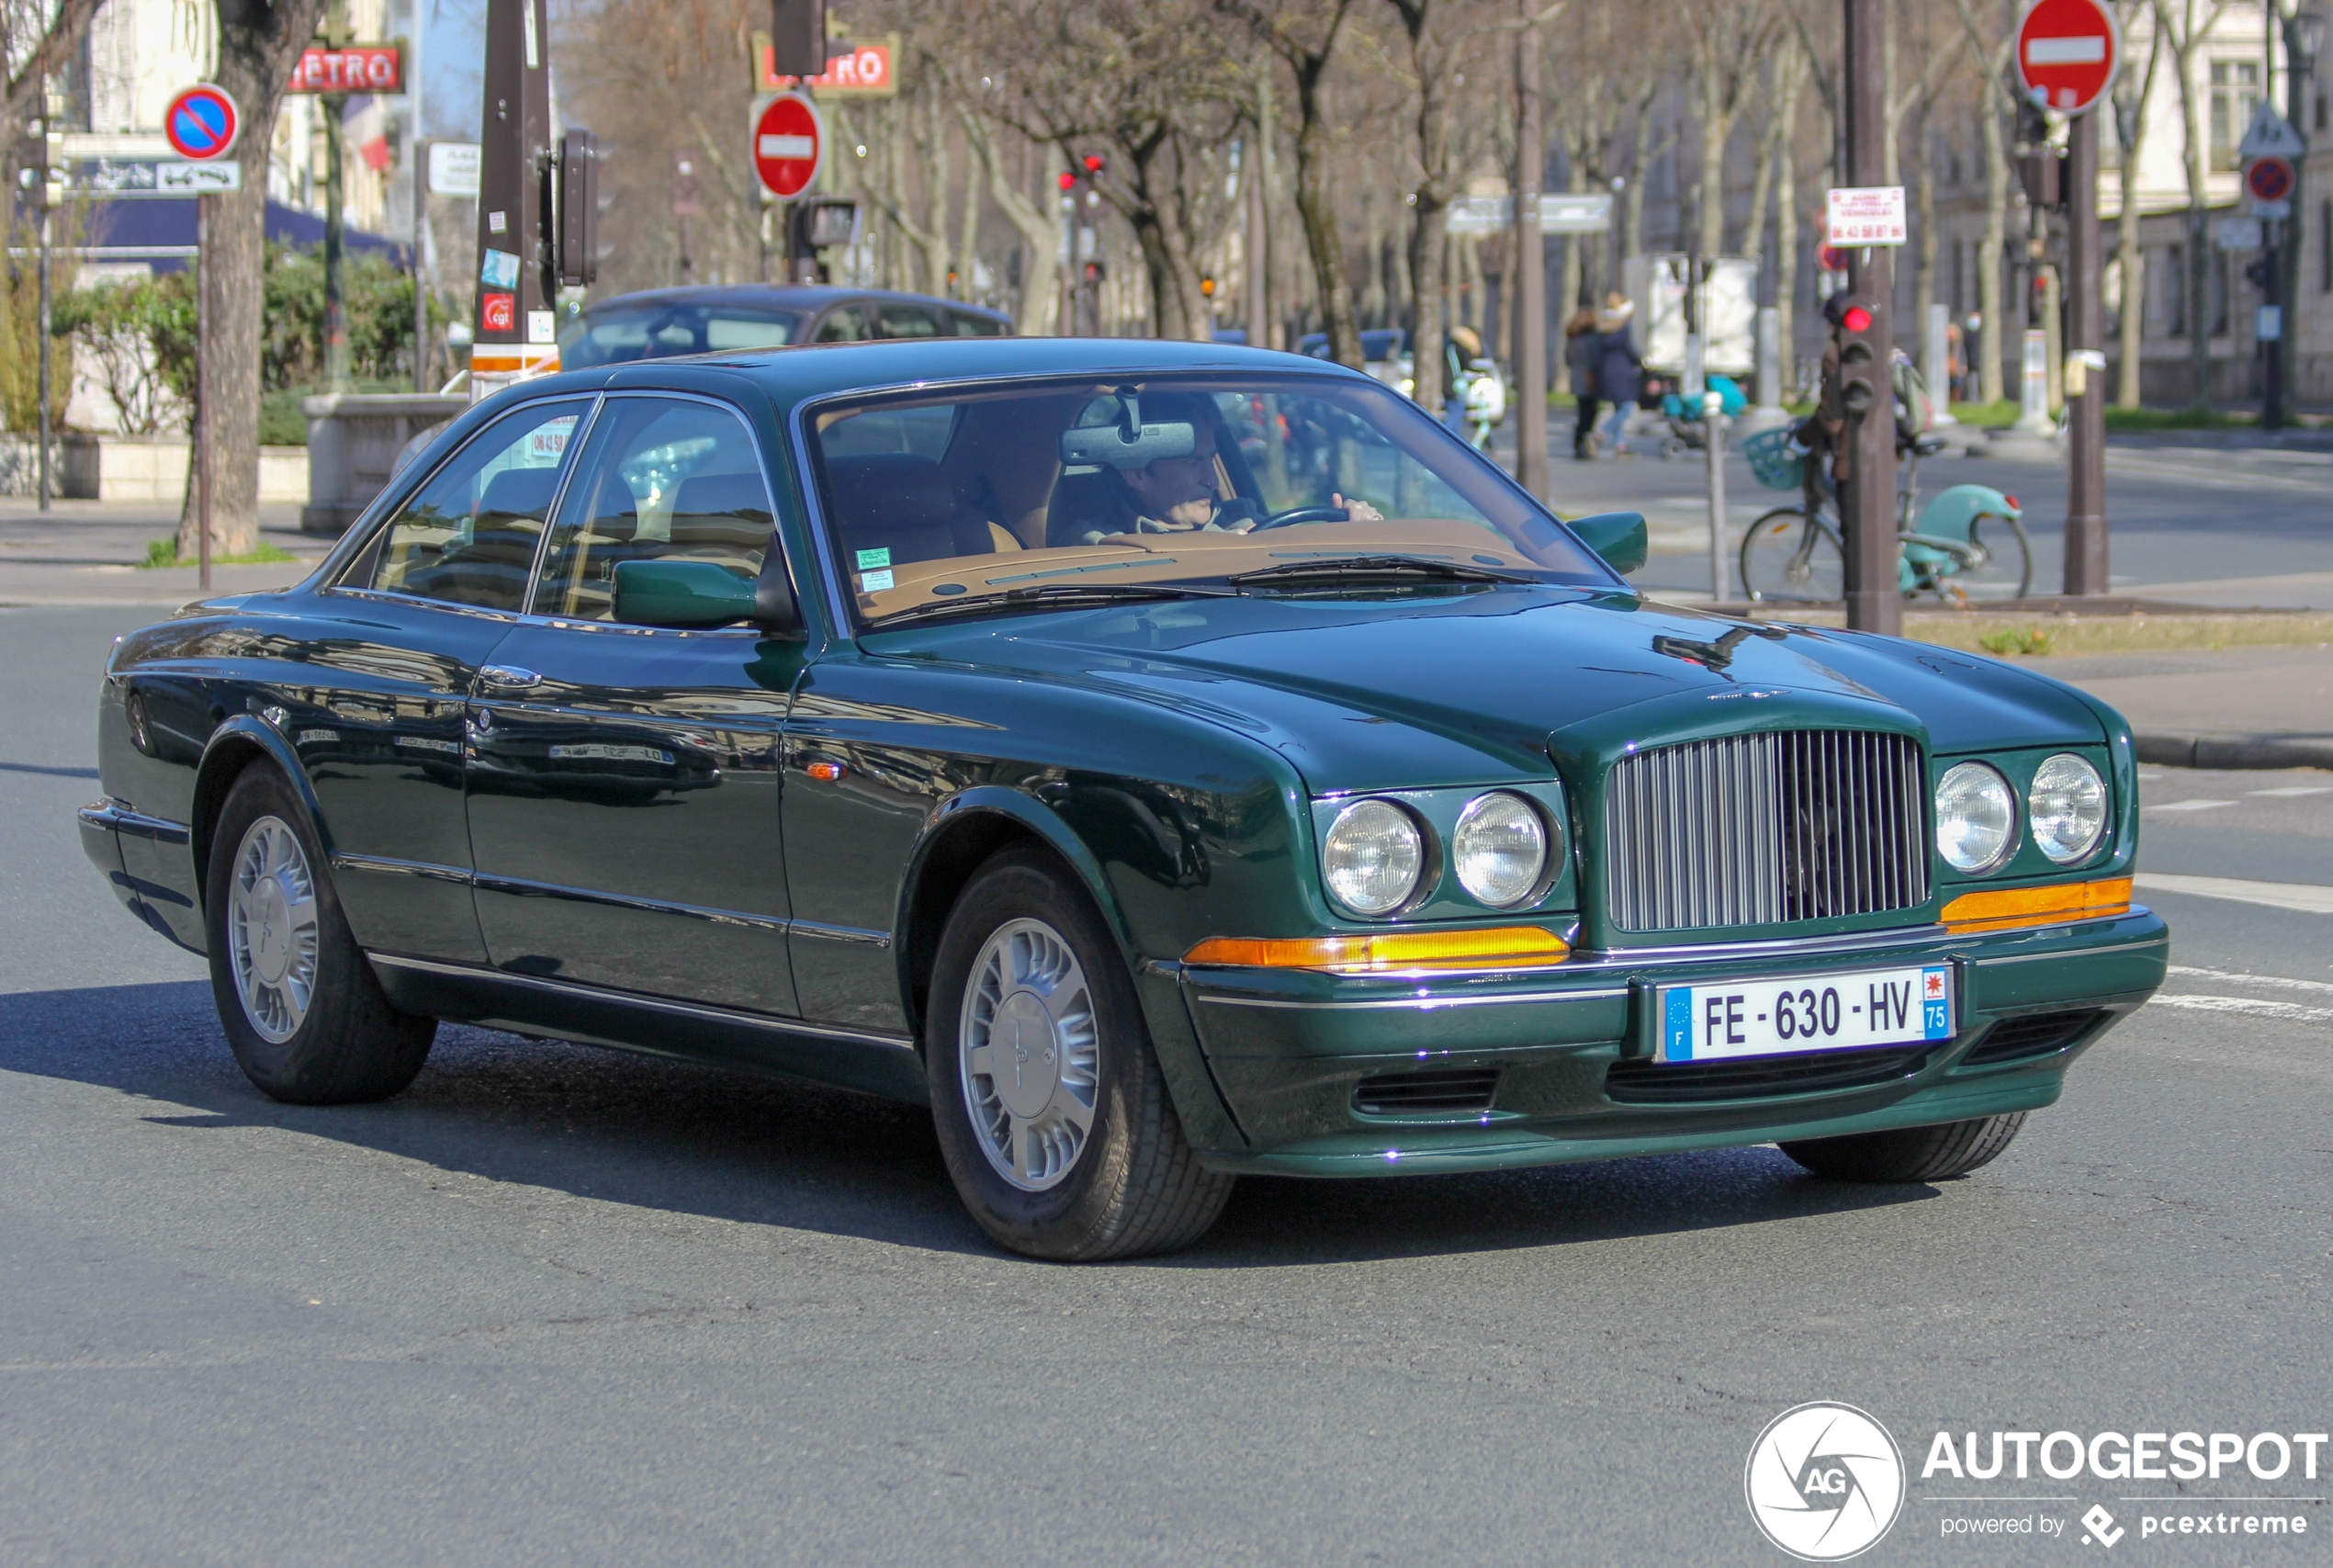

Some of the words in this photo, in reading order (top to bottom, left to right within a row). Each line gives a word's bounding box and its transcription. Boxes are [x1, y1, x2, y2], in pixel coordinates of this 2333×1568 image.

[492, 311, 509, 326] cgt
[1926, 1006, 1945, 1029] 75
[1675, 1032, 1684, 1045] F
